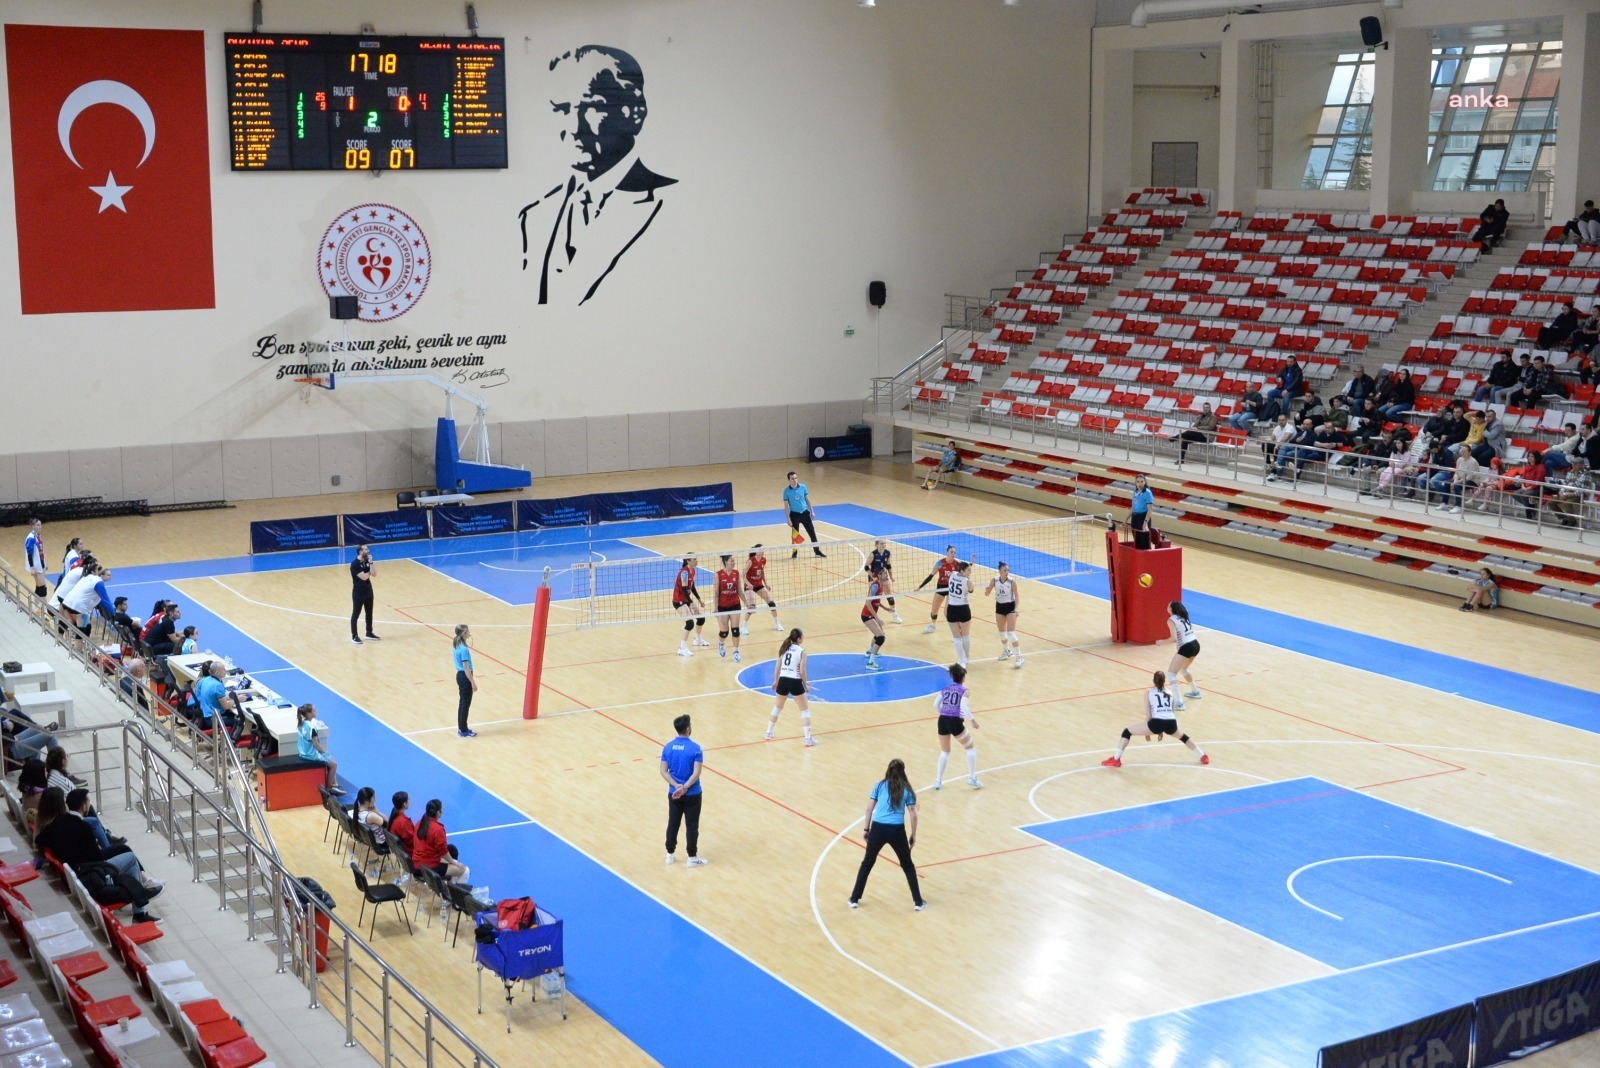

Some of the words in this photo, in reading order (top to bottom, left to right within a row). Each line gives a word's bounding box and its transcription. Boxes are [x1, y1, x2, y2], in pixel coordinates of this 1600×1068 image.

[350, 54, 368, 72] 17
[379, 54, 396, 74] 18
[364, 72, 378, 80] TIME
[349, 96, 354, 110] 1
[399, 96, 408, 111] 0
[368, 112, 378, 128] 2
[347, 140, 368, 150] SCORE
[391, 140, 412, 149] SCORE
[346, 150, 370, 169] 09
[390, 150, 414, 169] 07
[364, 225, 394, 236] GENÇLİK
[394, 234, 403, 243] VE
[401, 243, 411, 263] SPOR
[252, 334, 296, 359] Ben
[377, 335, 411, 354] zeki,
[416, 333, 454, 353] çevik
[456, 336, 473, 346] ve
[476, 334, 507, 349] aynı
[431, 353, 484, 368] severim
[949, 582, 962, 595] 35
[784, 653, 792, 666] 8
[943, 692, 959, 706] 20
[518, 944, 552, 957] TRYON
[1492, 991, 1590, 1048] STIGA
[1360, 1038, 1454, 1068] TIGA
